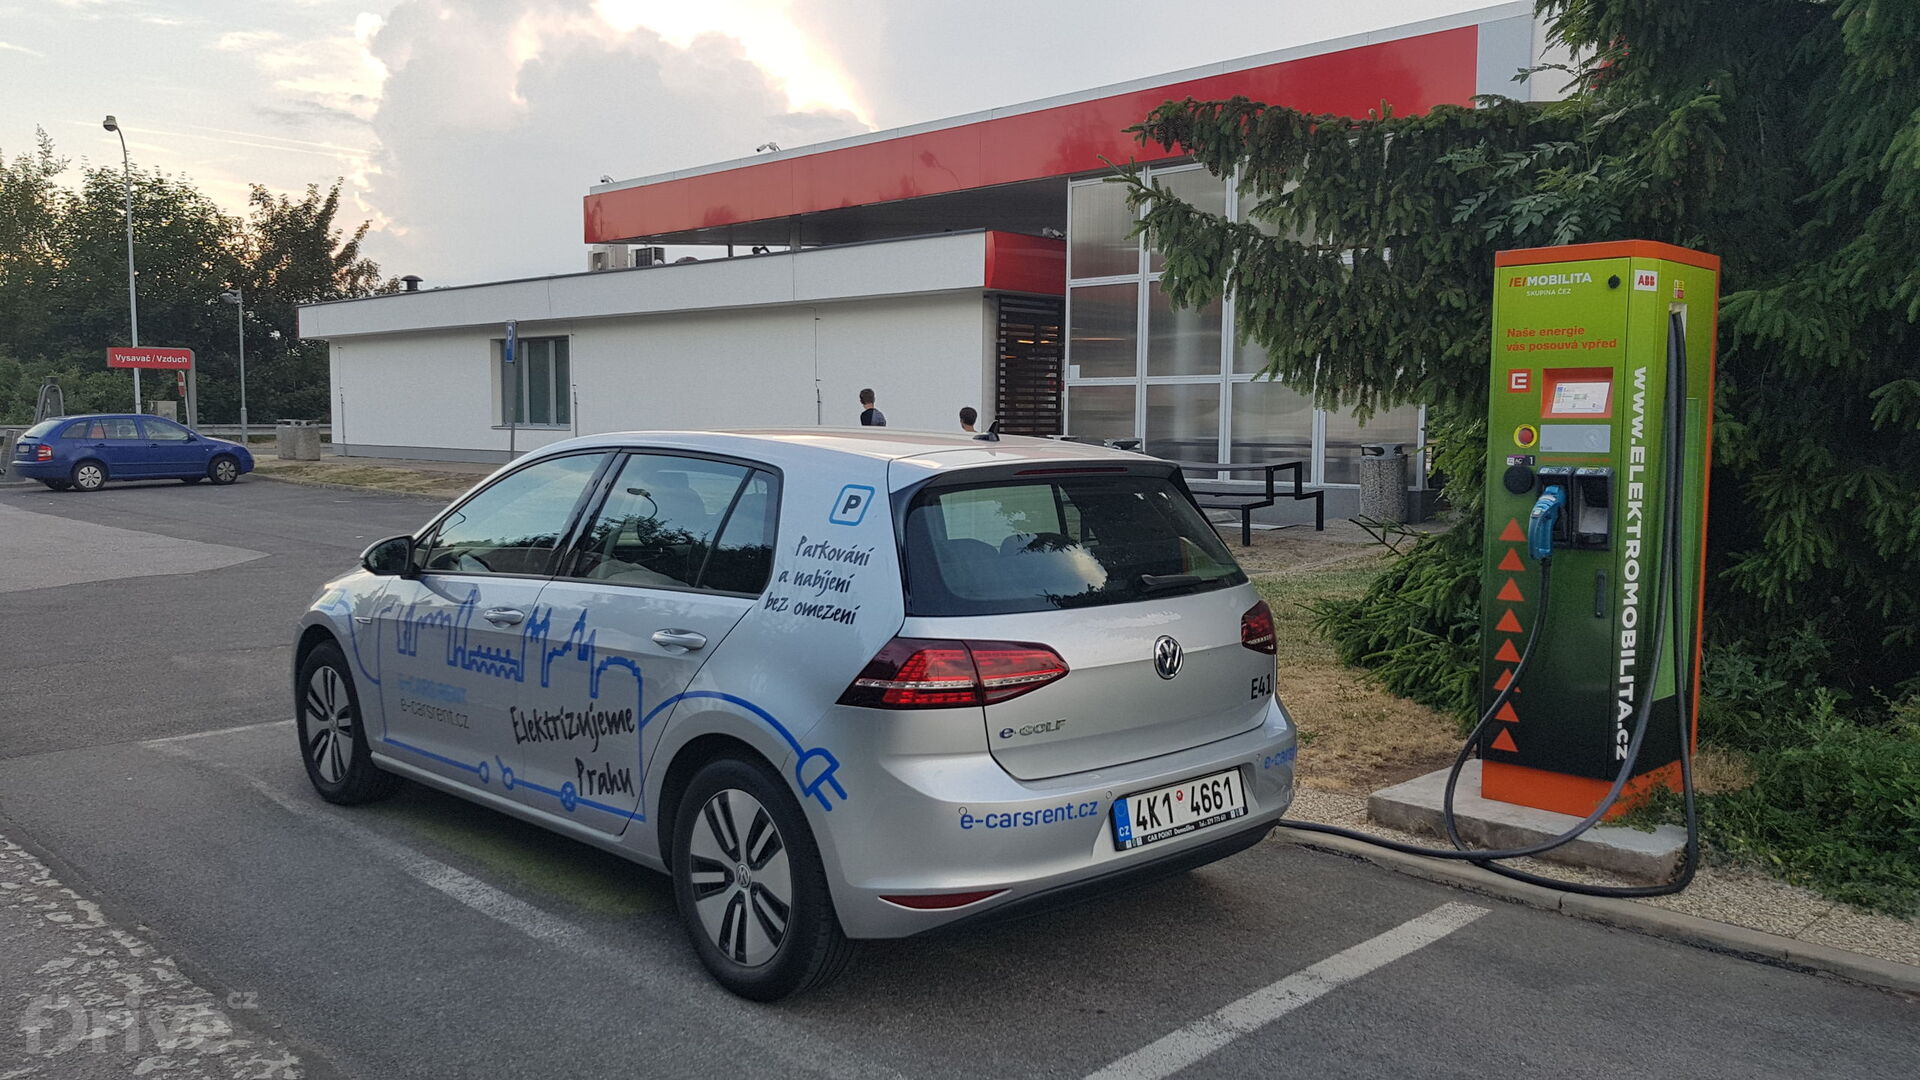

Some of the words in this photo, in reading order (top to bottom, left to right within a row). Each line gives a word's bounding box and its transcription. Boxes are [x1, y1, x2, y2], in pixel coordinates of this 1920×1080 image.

[1526, 289, 1556, 297] SKUPINA
[1557, 287, 1571, 295] ČEZ
[1637, 274, 1655, 286] ABB
[1506, 342, 1526, 351] vás
[1528, 340, 1578, 352] posouvá
[1582, 338, 1617, 350] vpřed
[1507, 327, 1536, 338] Naše
[1540, 326, 1585, 337] energie
[115, 354, 151, 363] Vysavač
[156, 355, 188, 363] Vzduch
[795, 535, 875, 566] Parkování
[778, 570, 789, 583] a
[793, 569, 856, 597] nabíjení
[764, 592, 789, 612] bez
[793, 602, 861, 624] omezení
[1250, 674, 1272, 700] E41
[400, 698, 470, 729] e-carsrent.cz
[510, 701, 636, 752] Elektrizujeme
[575, 757, 636, 797] Prahu
[960, 801, 1098, 829] e-carsrent.cz
[1136, 793, 1174, 831] 4K1
[1190, 776, 1234, 816] 4661
[1118, 825, 1131, 837] CZ
